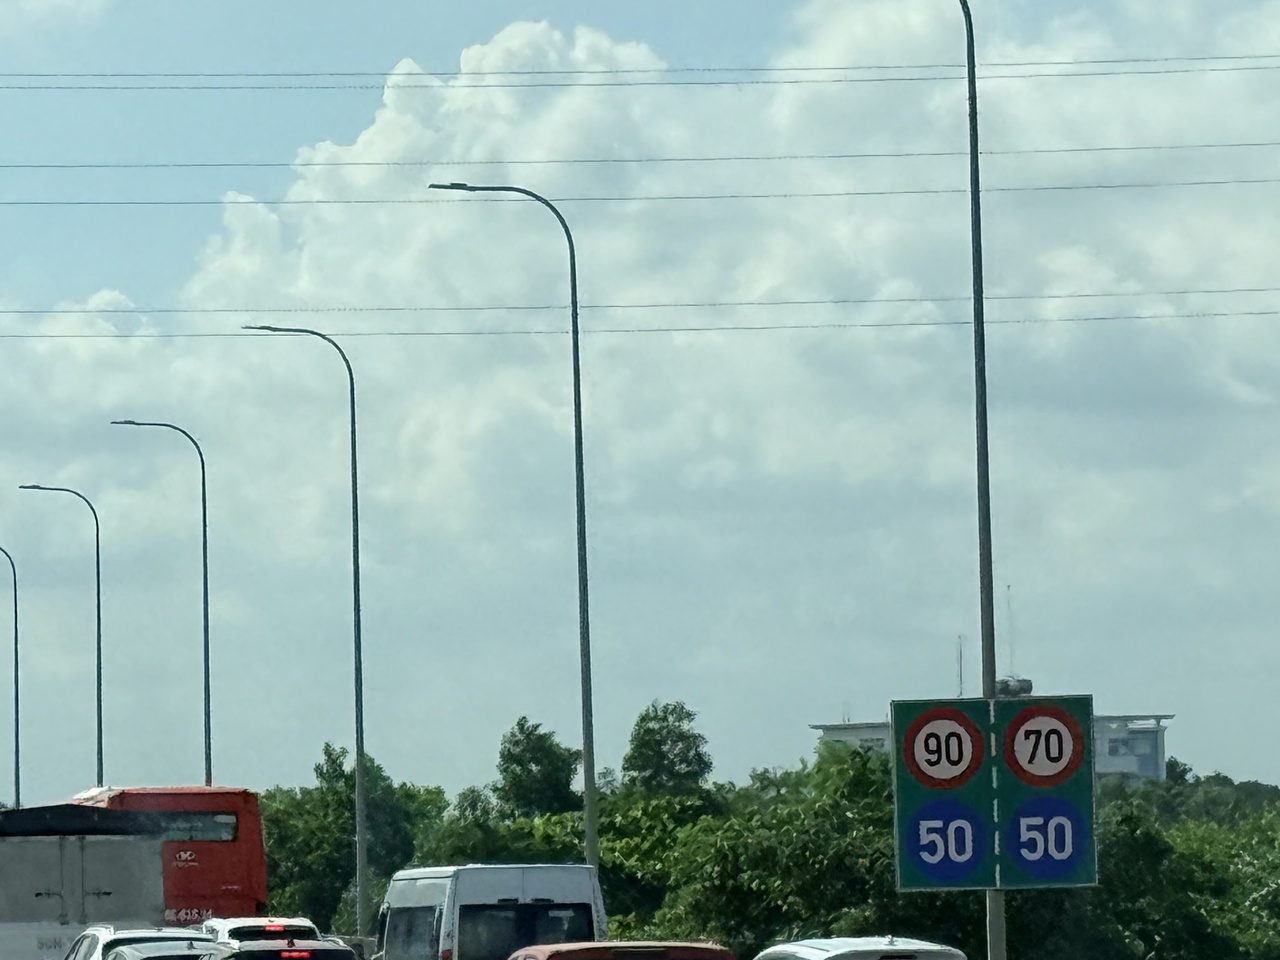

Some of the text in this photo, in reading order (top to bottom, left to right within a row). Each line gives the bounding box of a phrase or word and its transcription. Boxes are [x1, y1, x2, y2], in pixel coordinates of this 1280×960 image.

[924, 732, 964, 767] 90
[1024, 728, 1063, 764] 70
[919, 819, 973, 864] 50
[1020, 816, 1073, 861] 50
